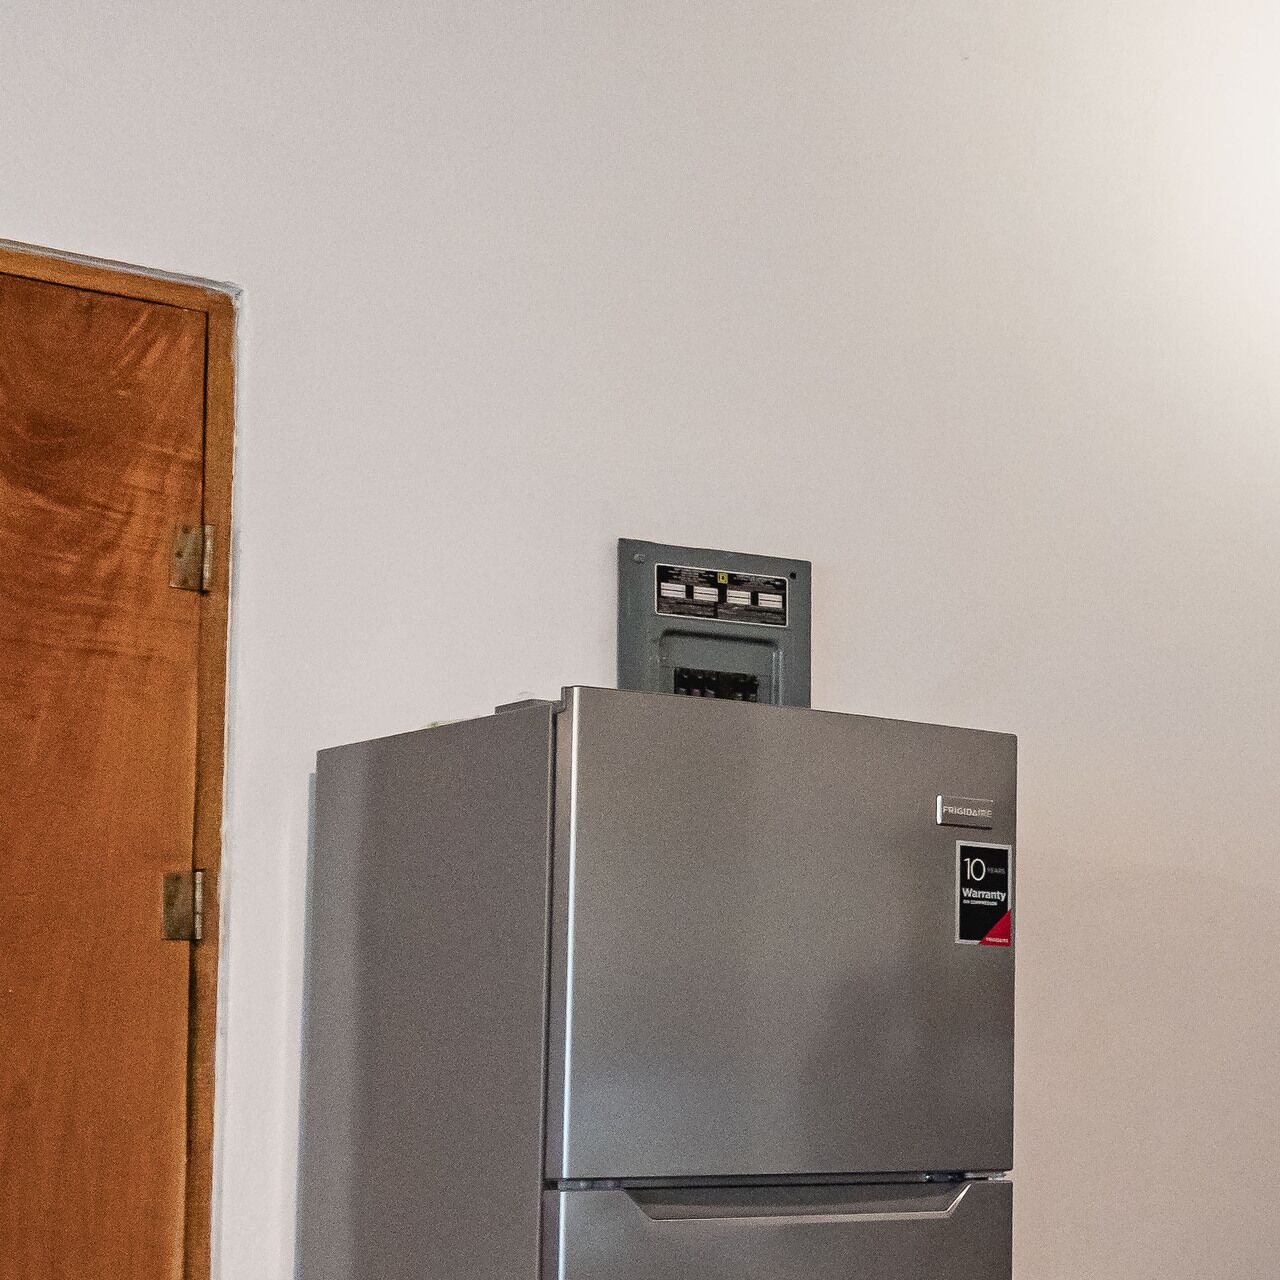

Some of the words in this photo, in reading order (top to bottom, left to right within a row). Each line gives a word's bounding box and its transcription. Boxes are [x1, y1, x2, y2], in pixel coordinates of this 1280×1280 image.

[943, 805, 993, 818] FRIGIDAIRE
[964, 857, 986, 881] 10
[962, 888, 1007, 902] Warranty
